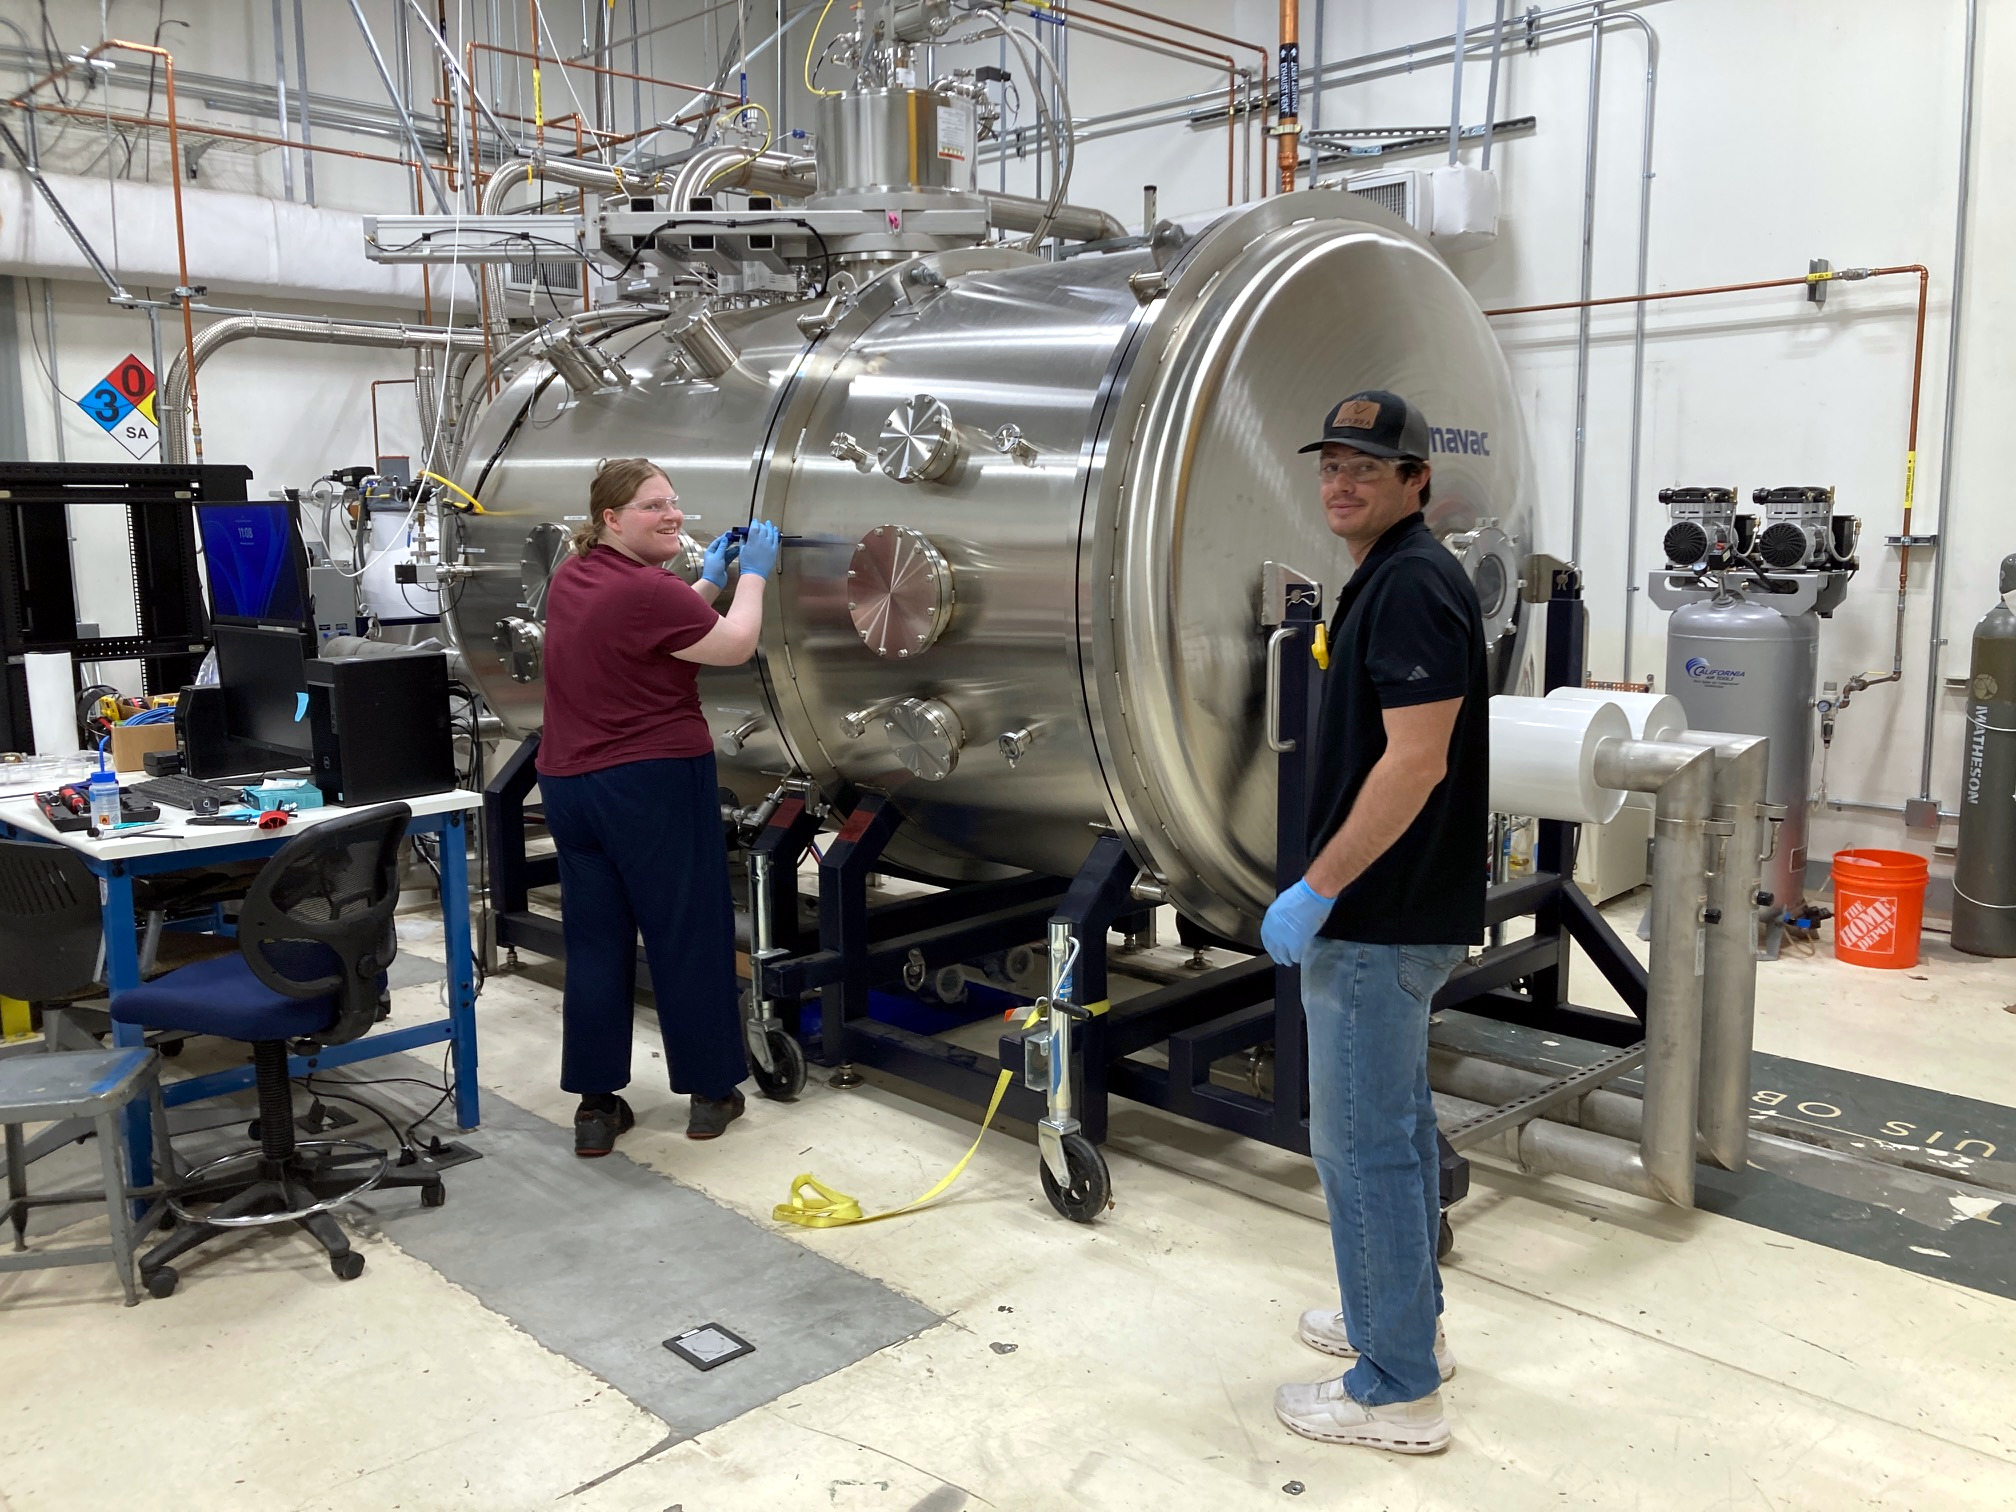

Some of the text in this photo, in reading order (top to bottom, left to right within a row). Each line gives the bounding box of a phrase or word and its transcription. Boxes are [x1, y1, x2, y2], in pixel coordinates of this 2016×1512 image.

[1280, 61, 1290, 113] EXHAUST VENT
[1290, 61, 1299, 113] EXHAUST VENT
[121, 364, 146, 398] 0
[94, 388, 119, 423] 3
[126, 426, 149, 440] SA
[1428, 426, 1490, 457] navac
[1904, 473, 1912, 503] COMPRESSED
[1693, 665, 1746, 677] CALIFORNIA
[1967, 705, 1988, 805] MATHESON
[1840, 898, 1896, 948] HOME
[1843, 900, 1866, 921] THE
[1857, 918, 1895, 951] DEPOT
